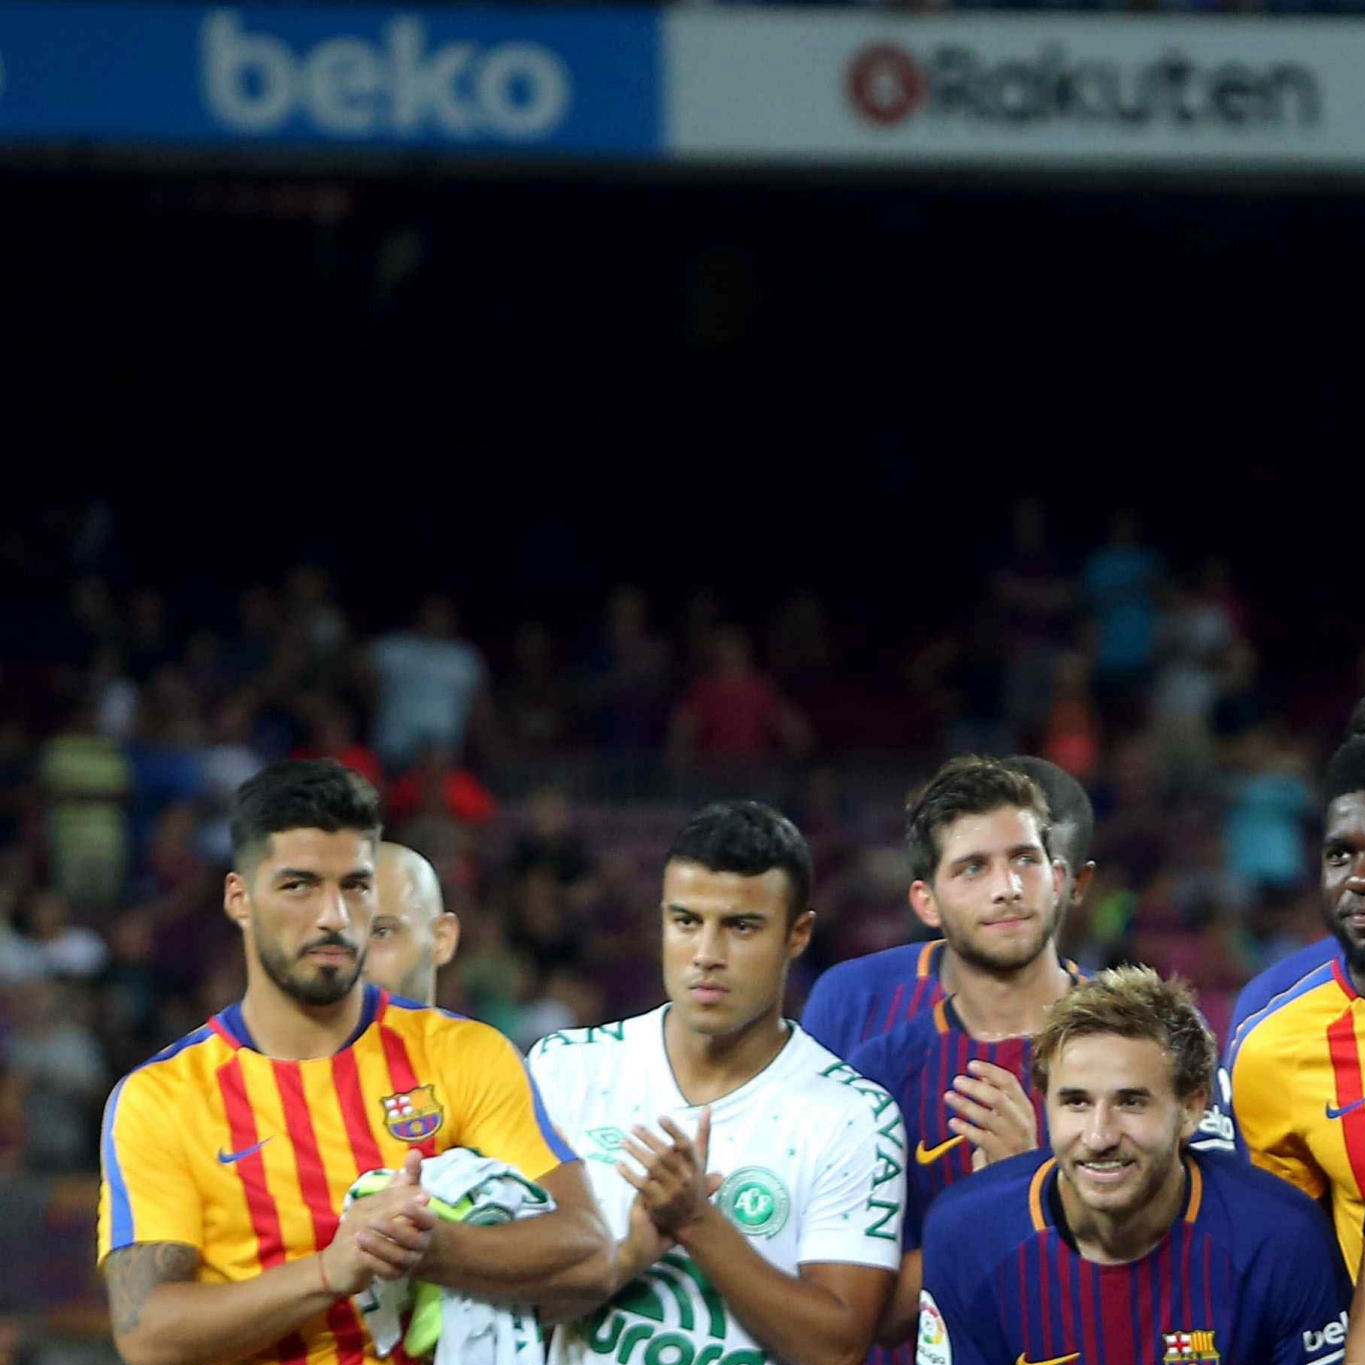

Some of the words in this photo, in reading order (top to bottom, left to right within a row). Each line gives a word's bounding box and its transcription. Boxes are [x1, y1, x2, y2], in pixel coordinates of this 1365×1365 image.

[205, 20, 570, 137] beko
[926, 42, 1322, 127] Rakuten
[816, 1059, 905, 1242] HAVAN
